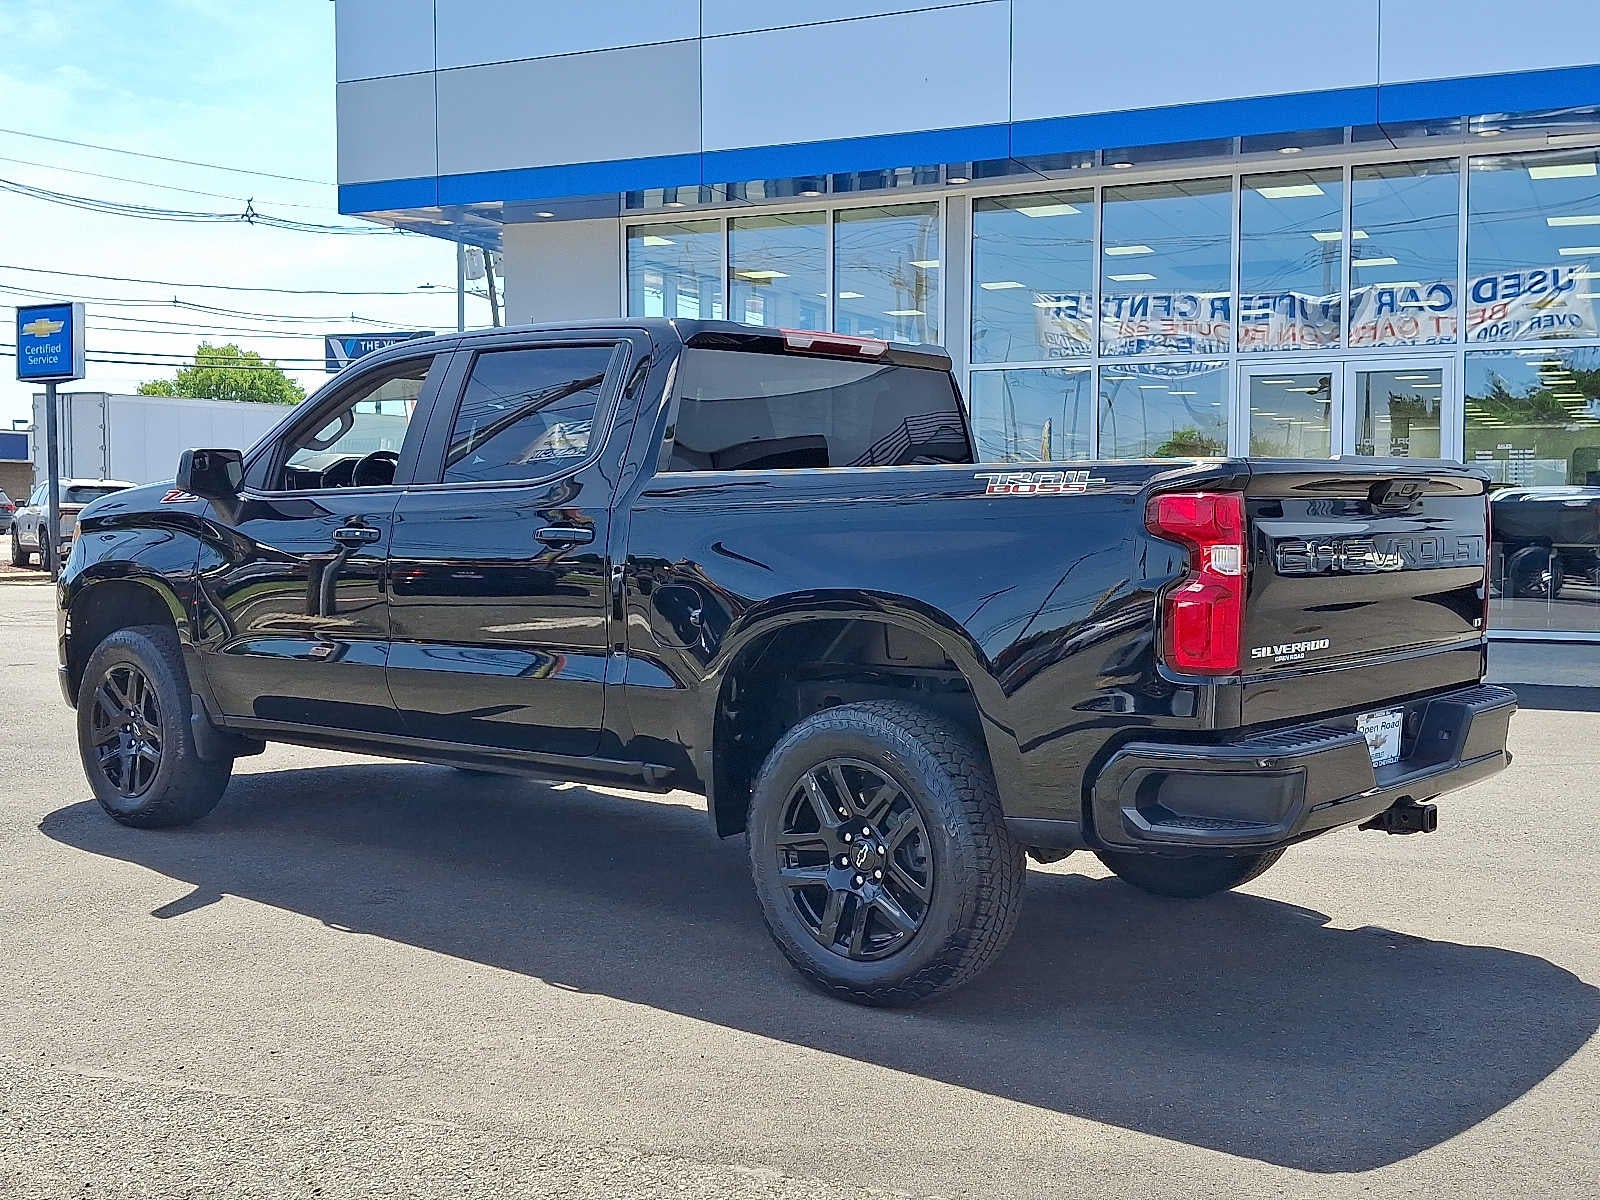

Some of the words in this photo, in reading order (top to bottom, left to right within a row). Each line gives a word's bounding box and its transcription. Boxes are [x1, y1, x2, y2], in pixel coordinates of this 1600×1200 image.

[25, 343, 61, 355] Certified
[360, 340, 381, 352] THE
[28, 354, 59, 365] Service
[974, 470, 1106, 485] TRAIL
[985, 483, 1087, 495] BOSS
[1276, 537, 1484, 574] CHEVROLET
[1251, 639, 1330, 659] SILVERADO
[1380, 720, 1400, 731] Road
